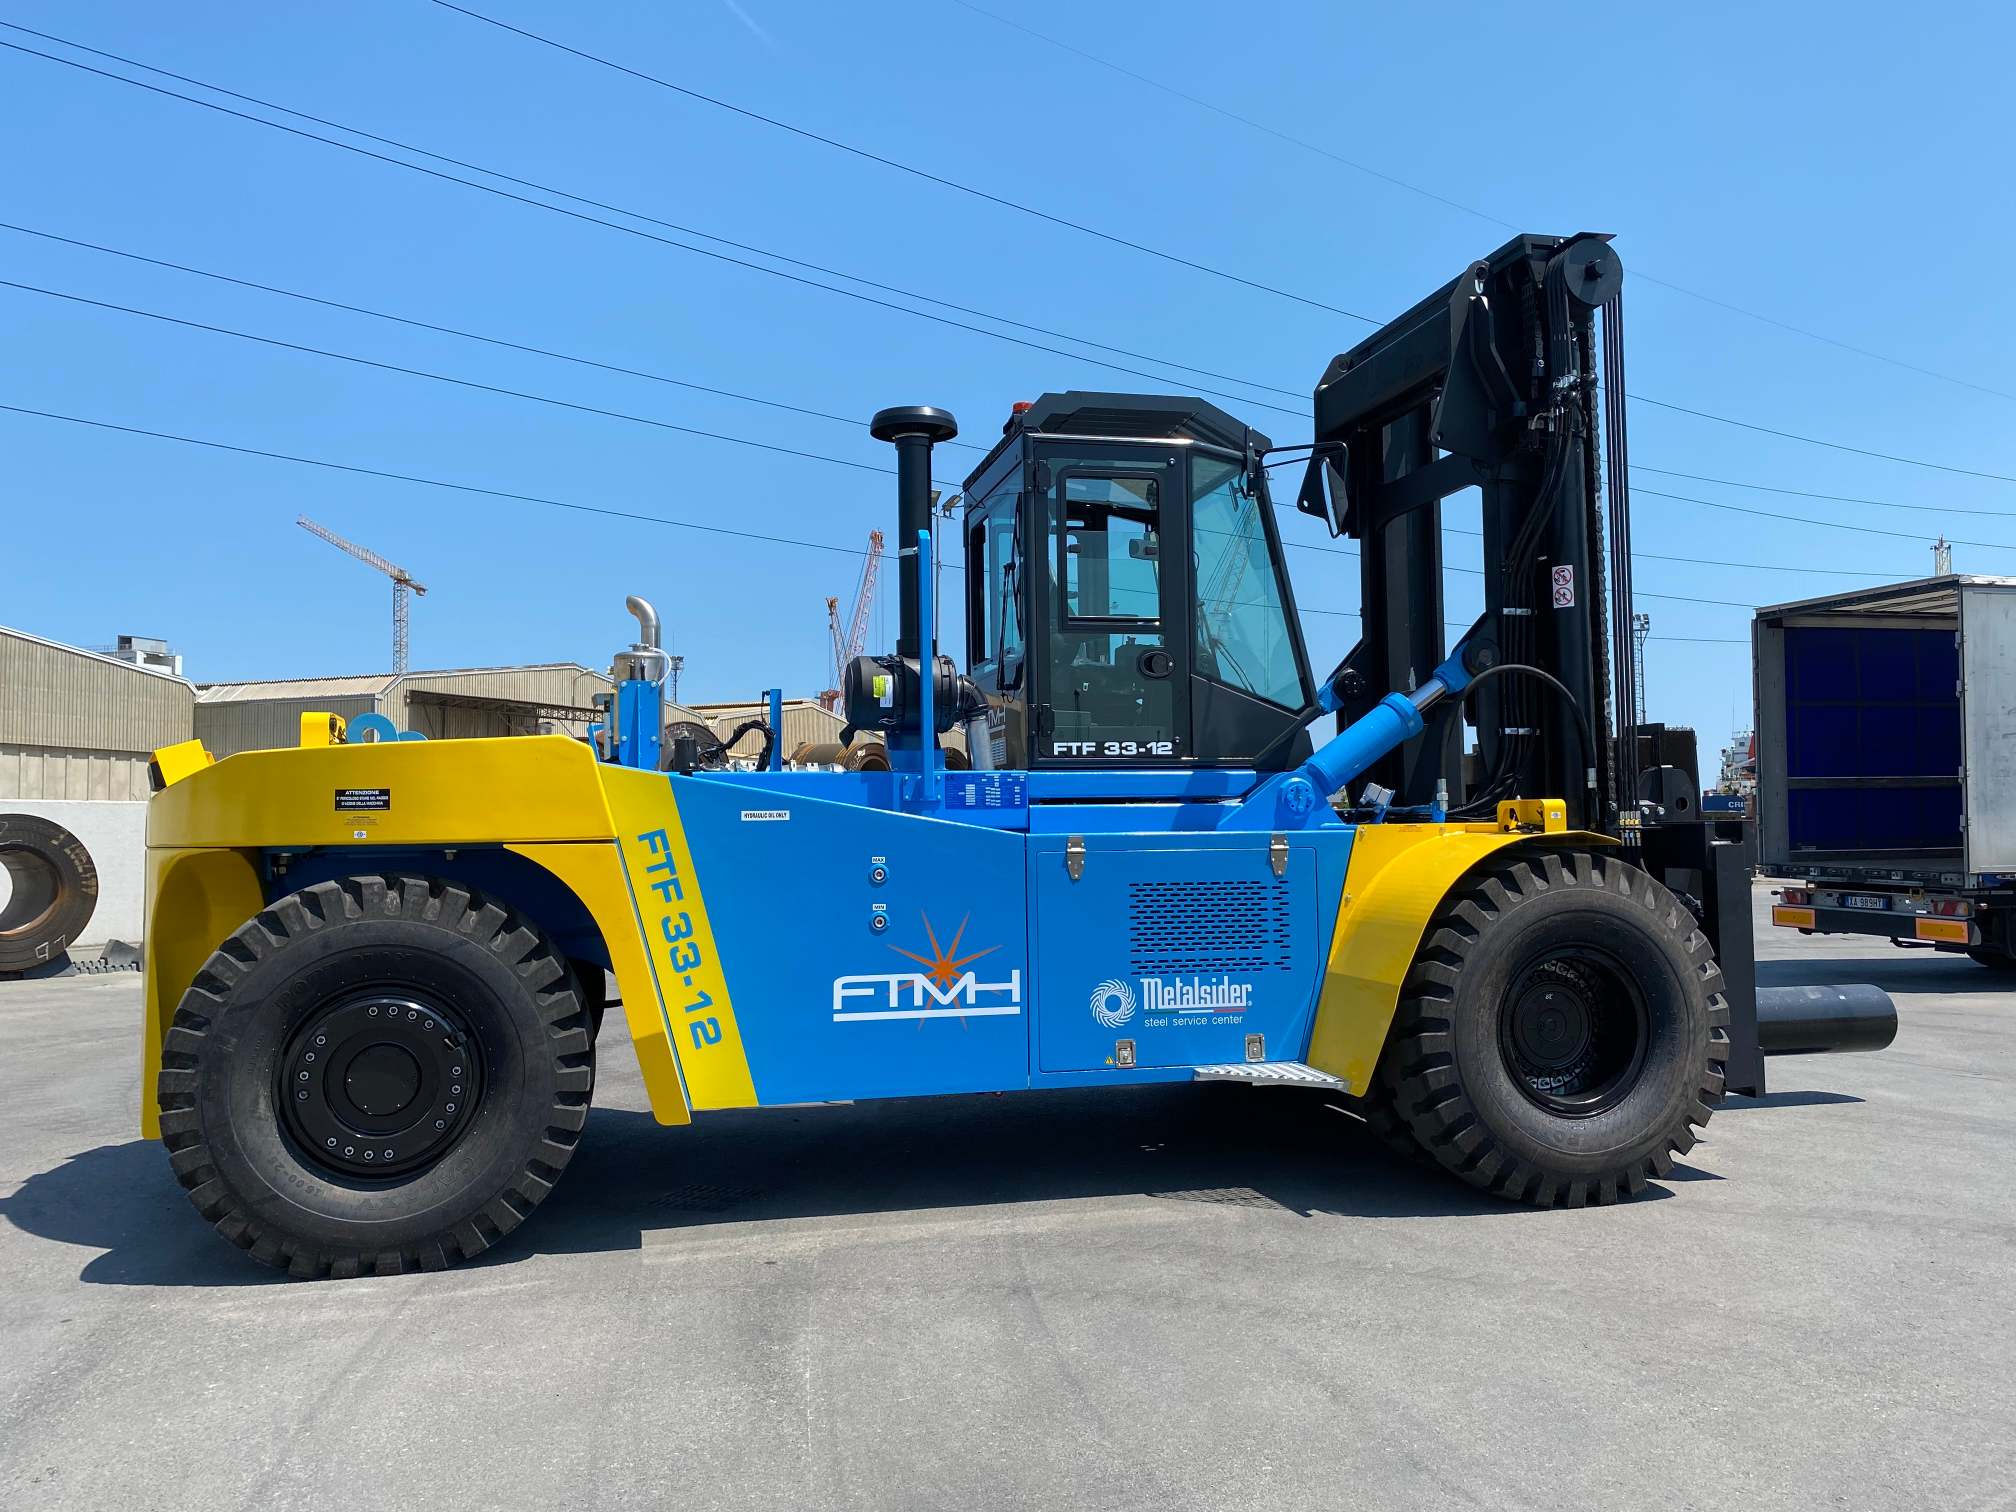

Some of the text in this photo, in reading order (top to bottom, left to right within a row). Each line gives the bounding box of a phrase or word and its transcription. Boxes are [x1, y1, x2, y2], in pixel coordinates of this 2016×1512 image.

[1053, 741, 1173, 756] FTF 33-12
[636, 828, 723, 1051] FTF 33-12
[832, 969, 1021, 1011] FTMH
[1139, 975, 1253, 1010] Metalsider
[1144, 1015, 1244, 1028] steel service center
